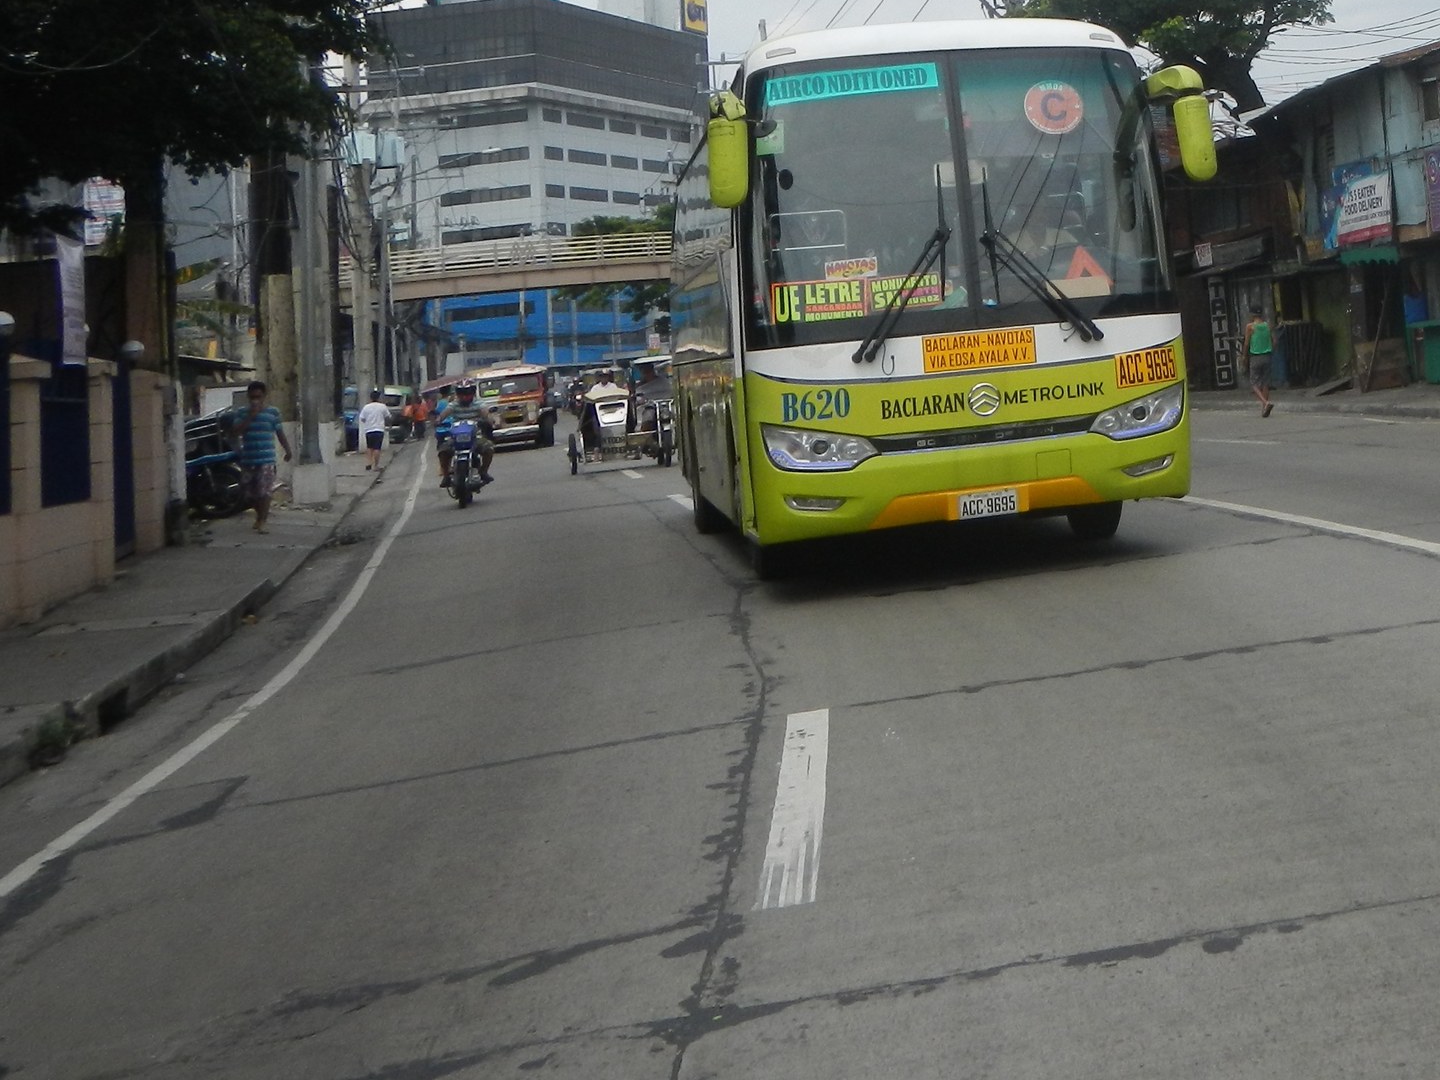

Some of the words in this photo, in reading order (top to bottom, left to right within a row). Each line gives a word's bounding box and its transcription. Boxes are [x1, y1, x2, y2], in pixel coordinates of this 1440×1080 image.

[1041, 92, 1067, 121] C
[1357, 184, 1376, 201] EATERY
[1359, 196, 1383, 213] DELIVERY
[775, 284, 801, 322] UE
[805, 281, 861, 305] LETRE
[805, 310, 864, 322] MONUMENTO
[930, 354, 946, 369] VIA
[949, 351, 976, 367] EDSA
[978, 349, 1010, 365] AYALA
[1012, 347, 1031, 361] V.V.
[1119, 352, 1146, 385] ACC
[1147, 347, 1176, 382] 9695
[781, 387, 851, 423] B620
[881, 392, 965, 420] BACLARAN
[962, 499, 984, 517] ACC
[986, 495, 1016, 514] 9695
